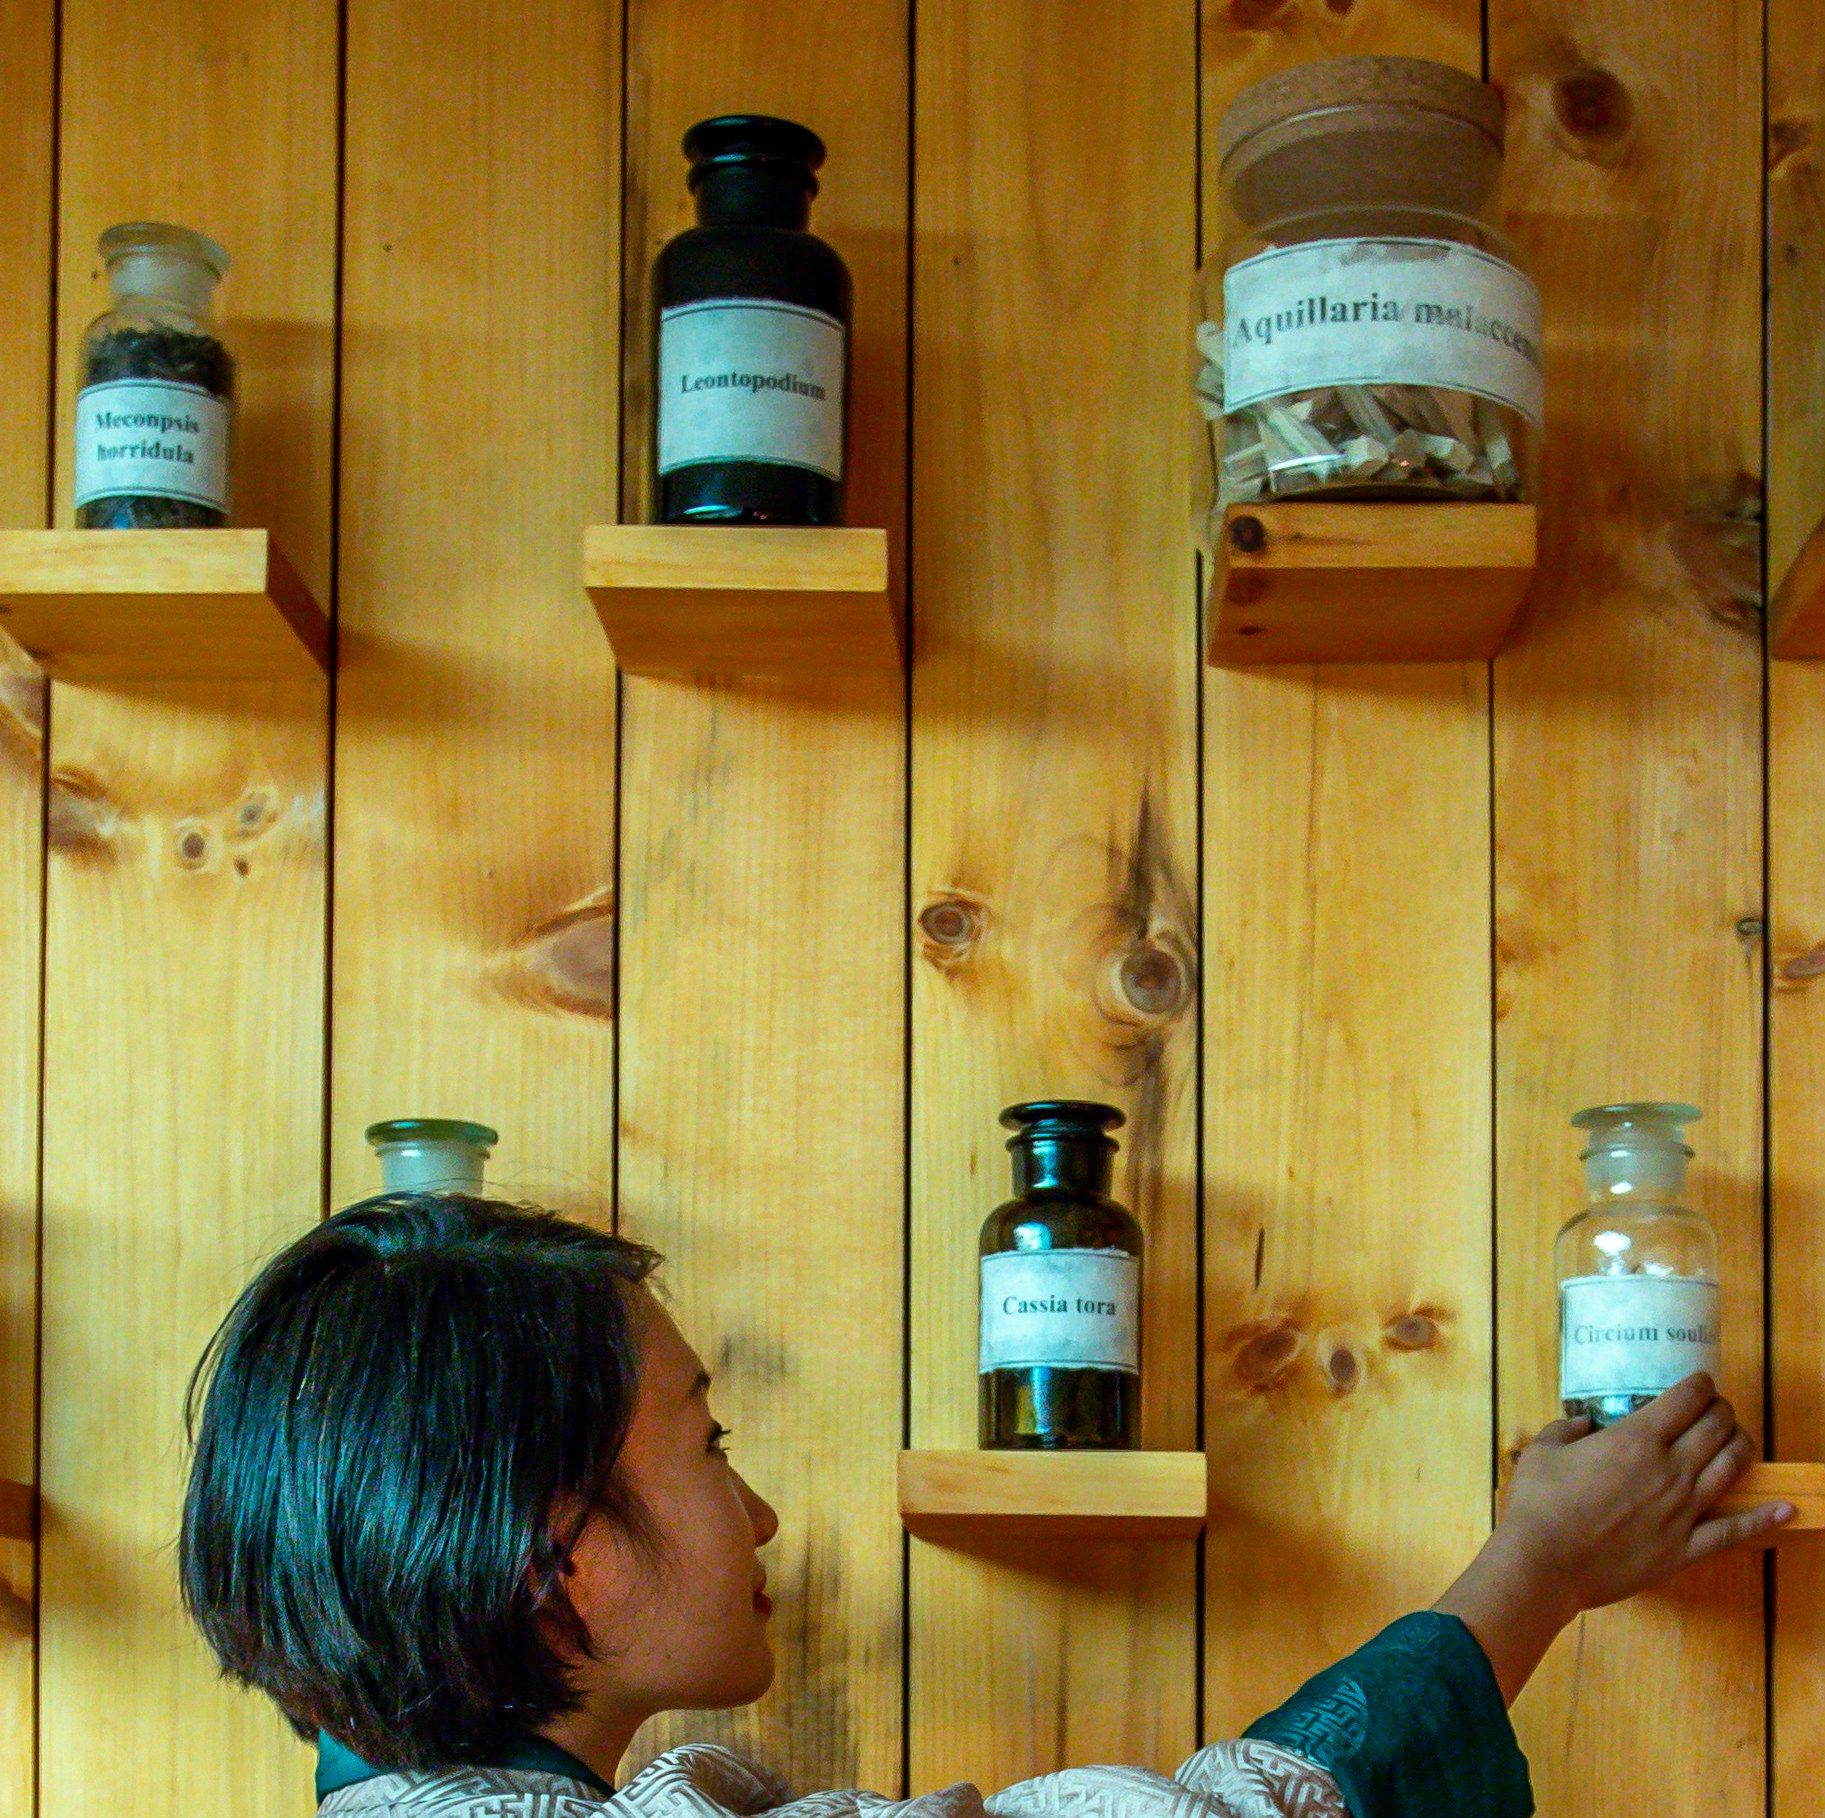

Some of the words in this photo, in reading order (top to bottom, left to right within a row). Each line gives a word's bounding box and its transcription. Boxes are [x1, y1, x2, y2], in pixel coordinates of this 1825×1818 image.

[1232, 293, 1399, 346] Aquillaria
[681, 371, 826, 401] Leontopodium
[97, 440, 194, 464] horridula
[1003, 1295, 1068, 1315] Cassia
[1076, 1297, 1116, 1316] tora
